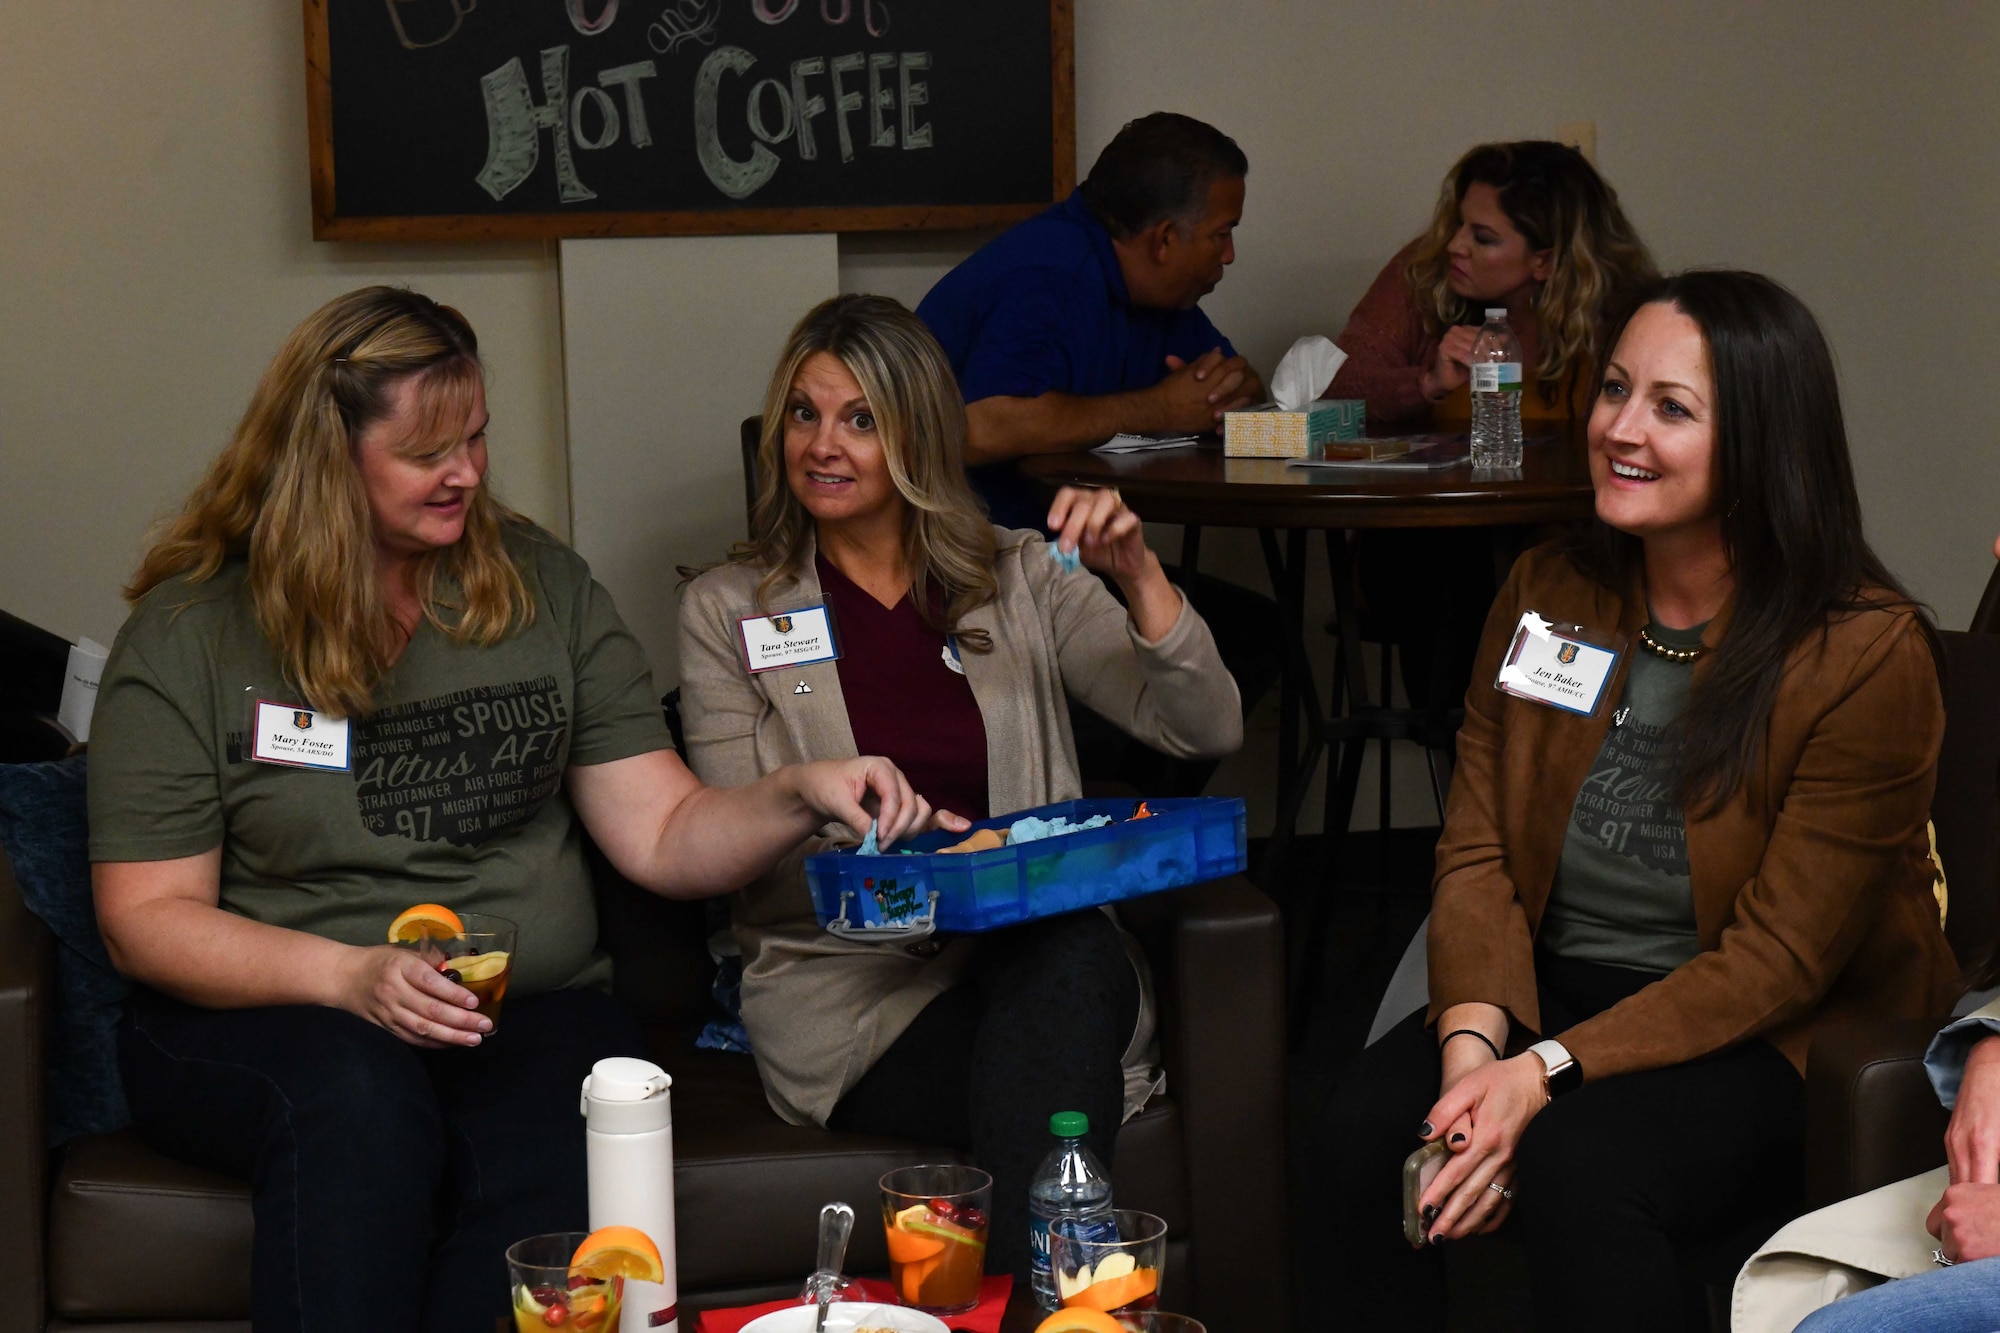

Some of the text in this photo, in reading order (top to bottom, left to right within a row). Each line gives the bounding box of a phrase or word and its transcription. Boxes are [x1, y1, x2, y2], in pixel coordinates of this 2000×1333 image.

[475, 44, 935, 203] HOT COFFEE
[760, 637, 818, 652] Tara Stewart
[489, 675, 557, 697] HOMETOWN
[1524, 674, 1546, 688] Souse,
[1533, 667, 1583, 688] Jen Baker
[375, 716, 436, 736] TRIANGLE
[453, 689, 568, 738] SPOUSE
[271, 733, 334, 750] Mary Foster
[370, 738, 414, 756] POWER
[421, 730, 451, 748] AMW
[353, 751, 476, 790] Altus
[357, 783, 452, 812] STRATOTANKER
[464, 776, 486, 793] AIR
[488, 769, 524, 787] FORCE
[441, 795, 489, 816] MIGHTY
[395, 805, 432, 841] 97
[458, 816, 482, 834] USA
[1640, 823, 1686, 841] MIGHTY
[1600, 820, 1633, 852] 97
[1652, 844, 1677, 860] USA
